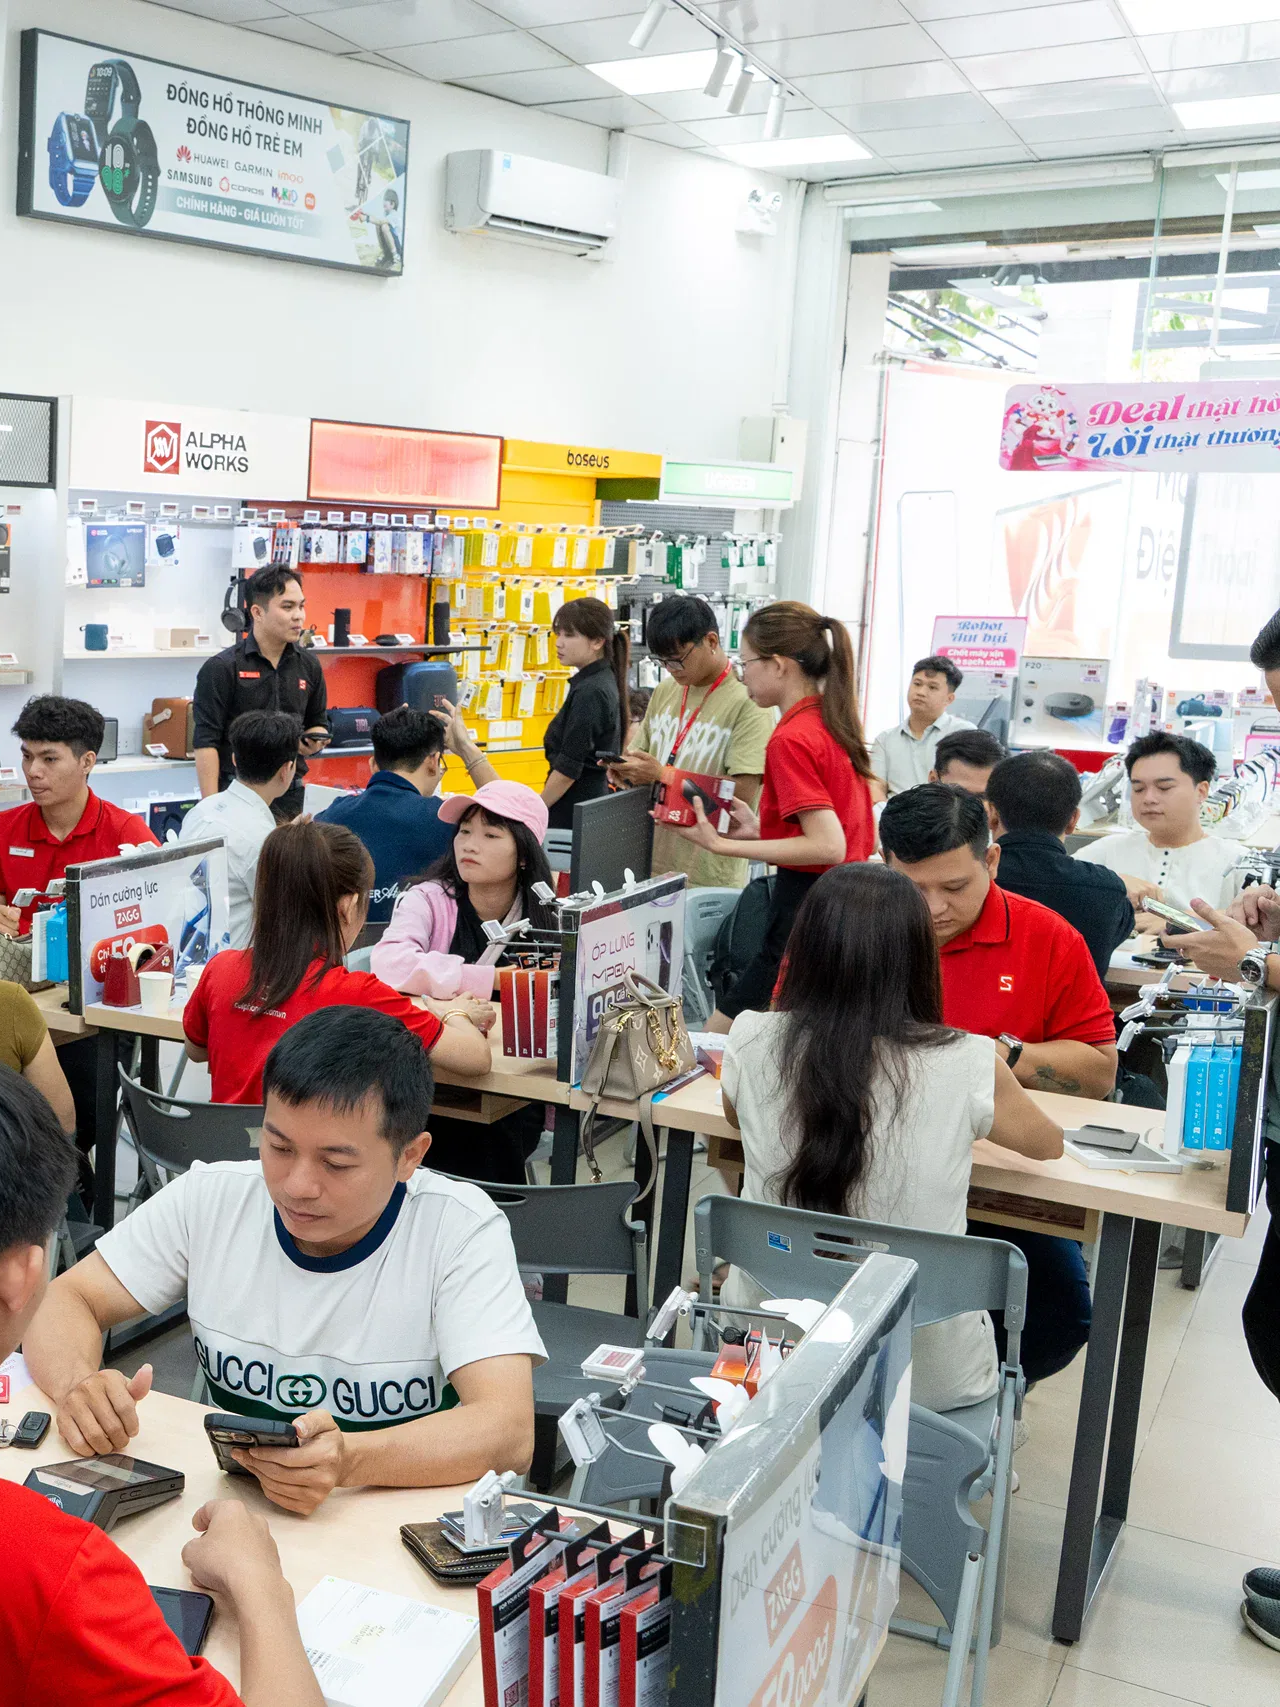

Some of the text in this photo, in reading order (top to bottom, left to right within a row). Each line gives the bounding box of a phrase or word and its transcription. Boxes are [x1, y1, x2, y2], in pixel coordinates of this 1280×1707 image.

[166, 80, 323, 136] ĐỒNG HỒ THÔNG MINH
[186, 114, 303, 158] ĐỒNG HỒ TRẺ EM
[167, 169, 213, 187] SAMSUNG
[193, 153, 304, 184] HUAWEI GARMIN imoo
[176, 195, 208, 213] CHÍNH
[210, 201, 237, 218] HÃNG
[244, 206, 261, 223] GIÁ
[1087, 393, 1187, 427] Deal
[1186, 398, 1242, 422] thật
[185, 431, 247, 452] ALPHA
[1087, 425, 1154, 459] Lời
[1154, 431, 1201, 453] thật
[185, 452, 249, 474] WORKS
[567, 450, 610, 469] baseus
[90, 881, 159, 909] Dán cường lực
[115, 908, 140, 925] ZAGG
[194, 1336, 436, 1418] GUCCI GUCCI
[729, 1486, 802, 1621] Dán cường
[767, 1556, 802, 1632] ZAGG
